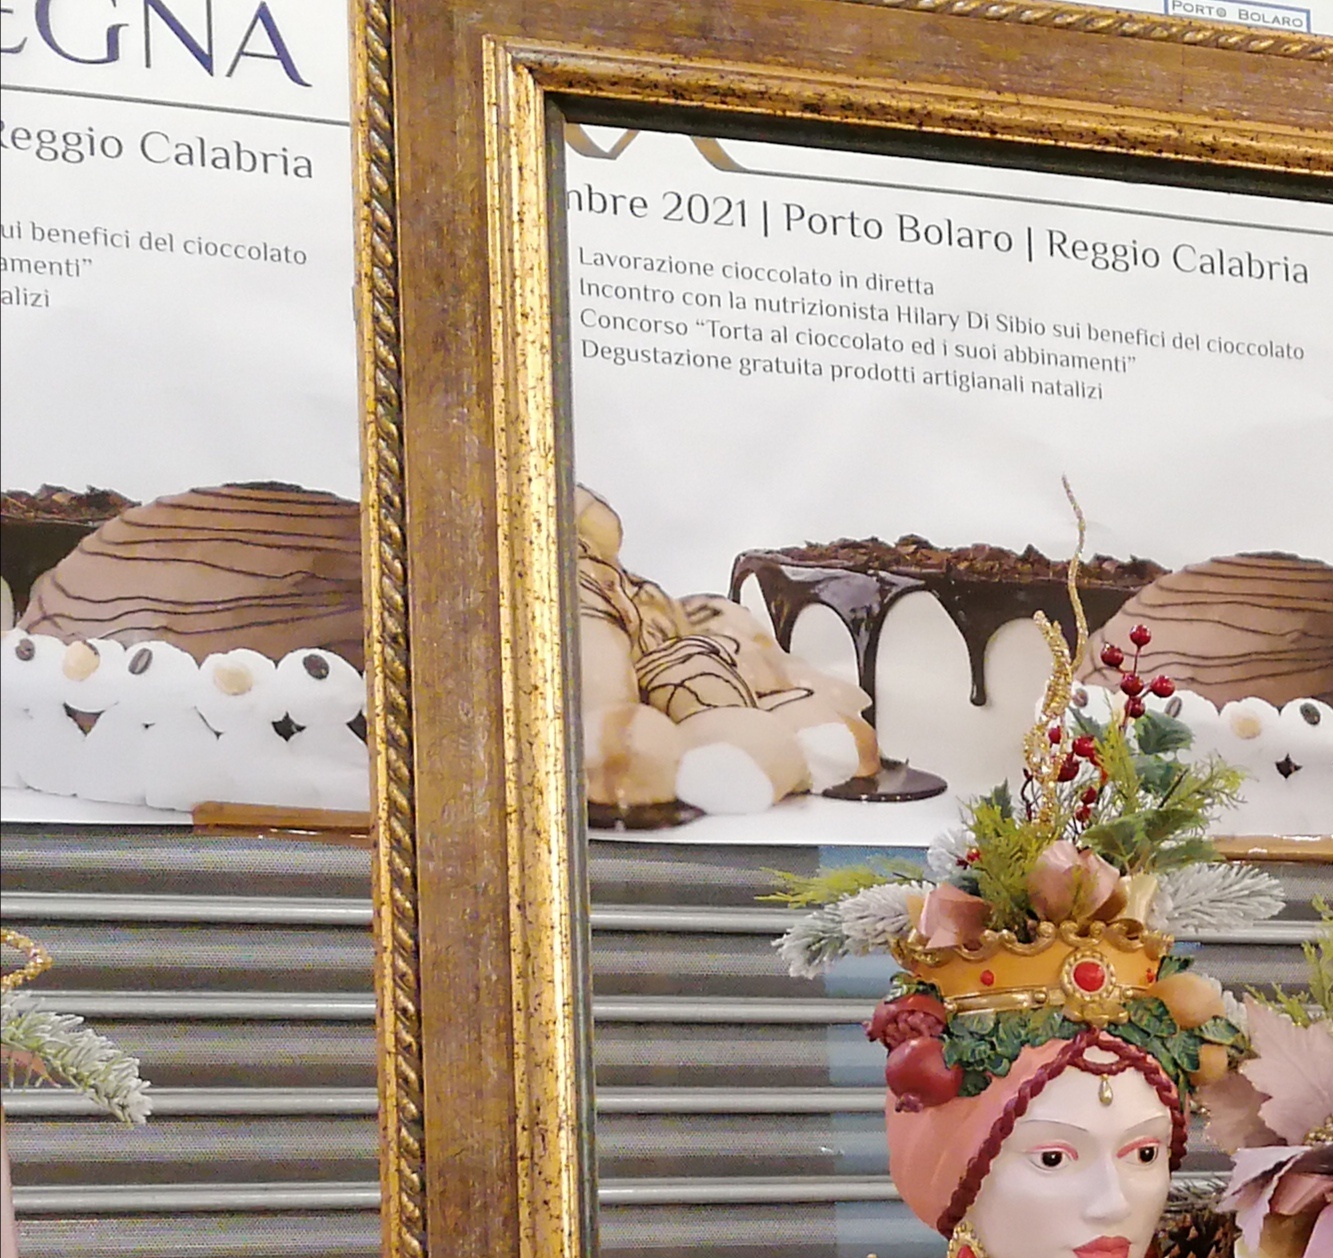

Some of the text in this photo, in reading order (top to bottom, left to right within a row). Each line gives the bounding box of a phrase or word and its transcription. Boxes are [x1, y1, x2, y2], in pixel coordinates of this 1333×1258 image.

[1238, 9, 1304, 27] BOLARO
[140, 131, 313, 179] Calabria
[31, 221, 130, 249] benefici
[139, 231, 174, 252] del
[183, 237, 308, 265] cioccolato
[662, 191, 747, 227] 2021
[783, 203, 883, 240] Porto
[896, 213, 1013, 252] Bolaro
[1046, 229, 1160, 273] Reggio
[1172, 243, 1309, 284] Calabria
[578, 246, 935, 296] Lavorazione cioccolato in diretta
[580, 278, 1305, 360] Incontro con la nutrizionista Hilary Di Sibio sui benefici del cioccolato
[580, 308, 1136, 373] Concorso “Torta al cioccolato ed i suoi abbinamenti”
[581, 339, 1103, 400] Degustazione gratuita prodotti artigianali natalizi
